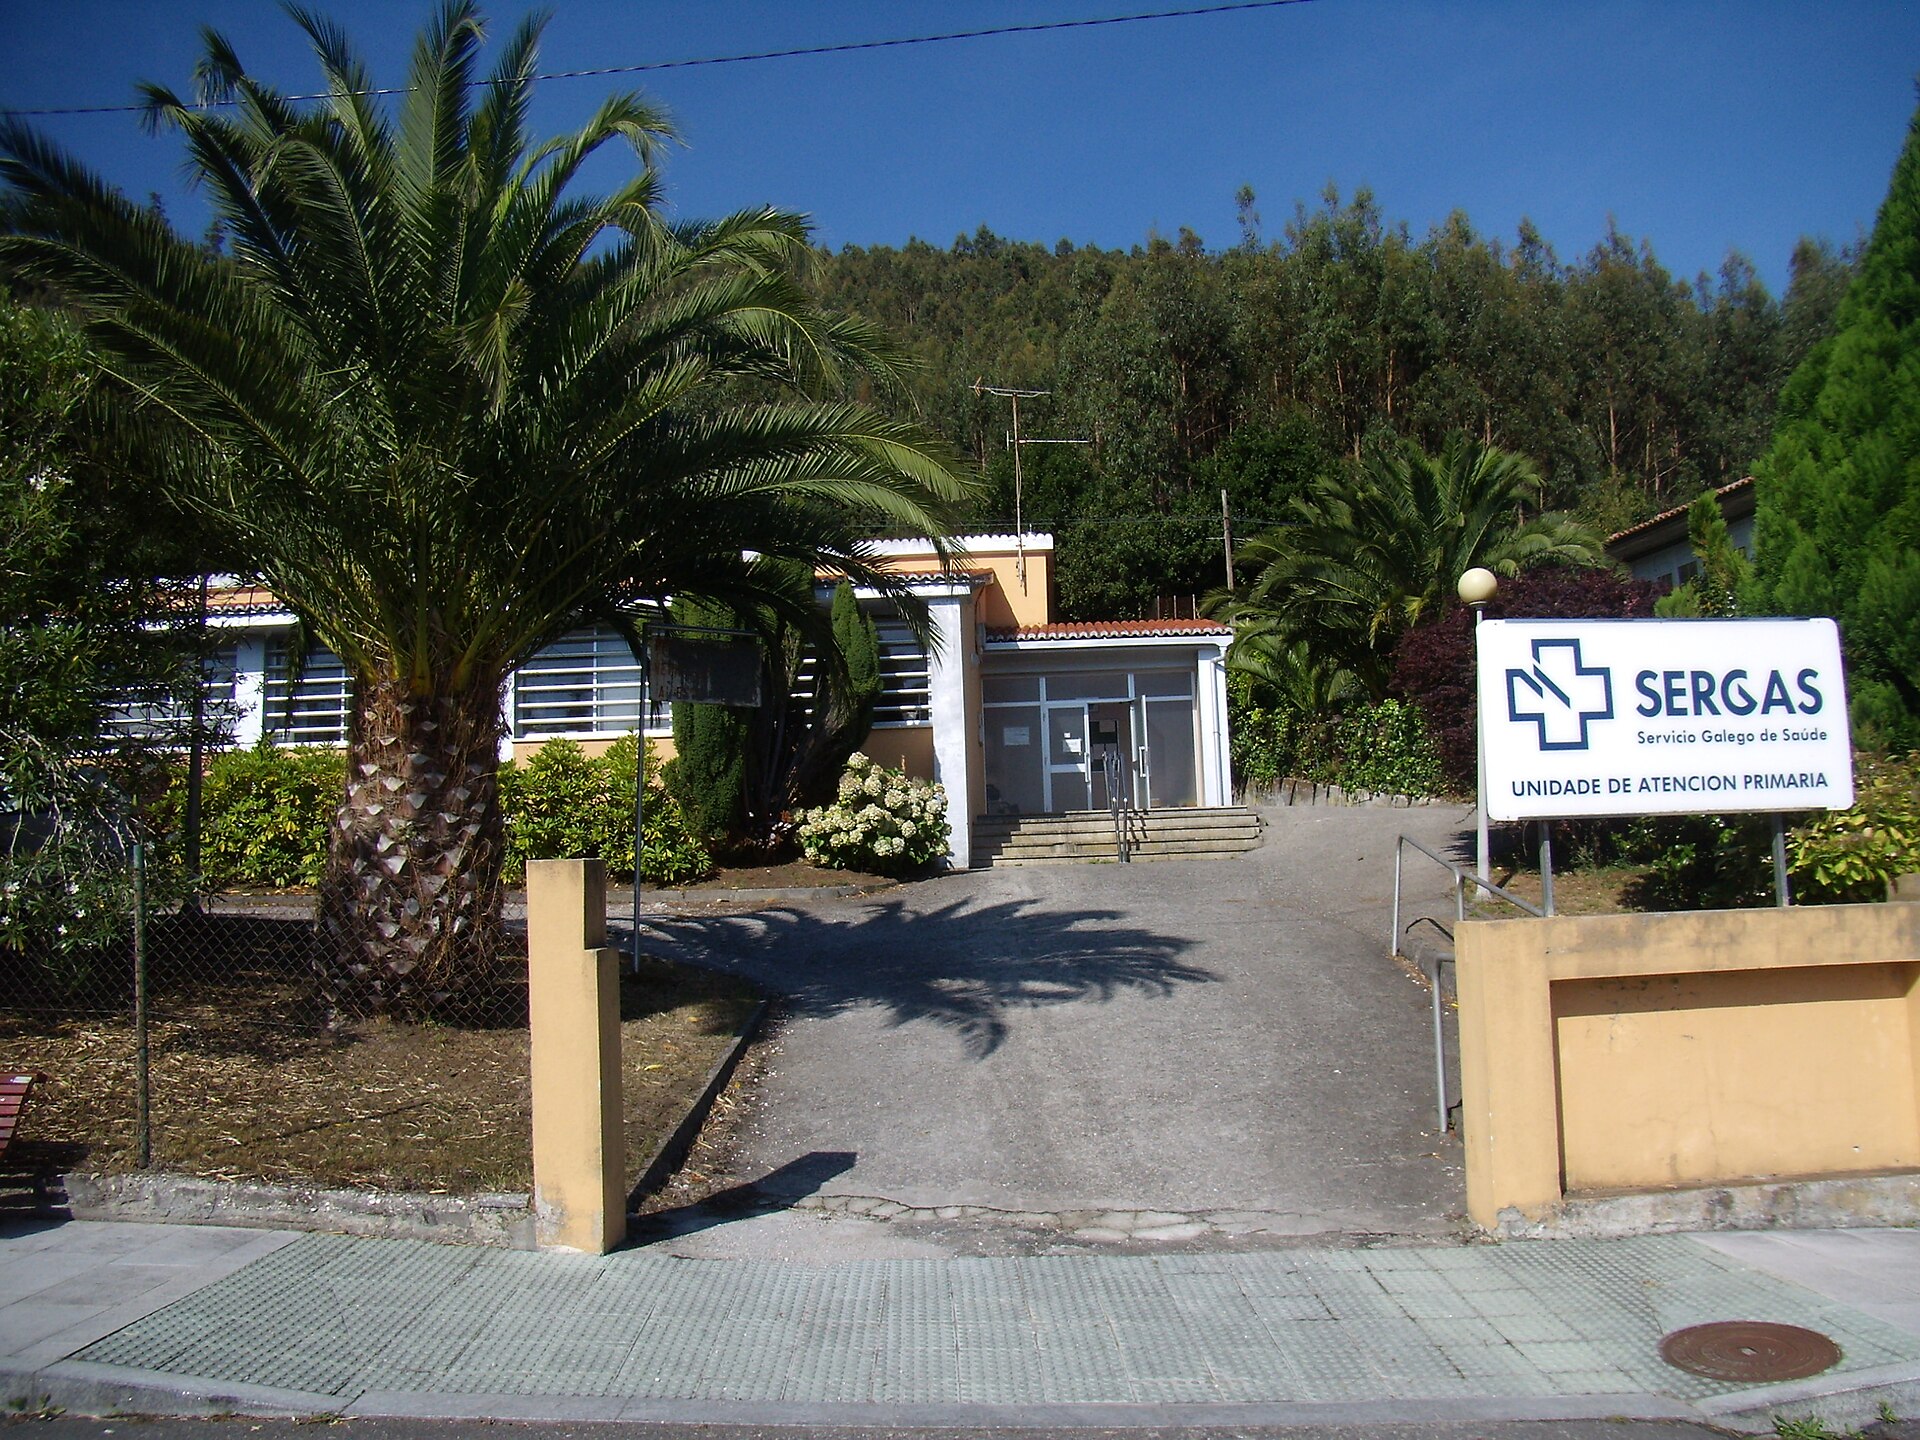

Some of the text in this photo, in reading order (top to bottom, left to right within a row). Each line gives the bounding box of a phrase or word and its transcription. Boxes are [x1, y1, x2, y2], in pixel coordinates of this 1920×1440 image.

[1635, 668, 1823, 717] SERGAS
[1637, 727, 1828, 746] Servicio Galego de Saúde
[1511, 772, 1829, 797] UNIDADE DE ATENCION PRIMARIA
